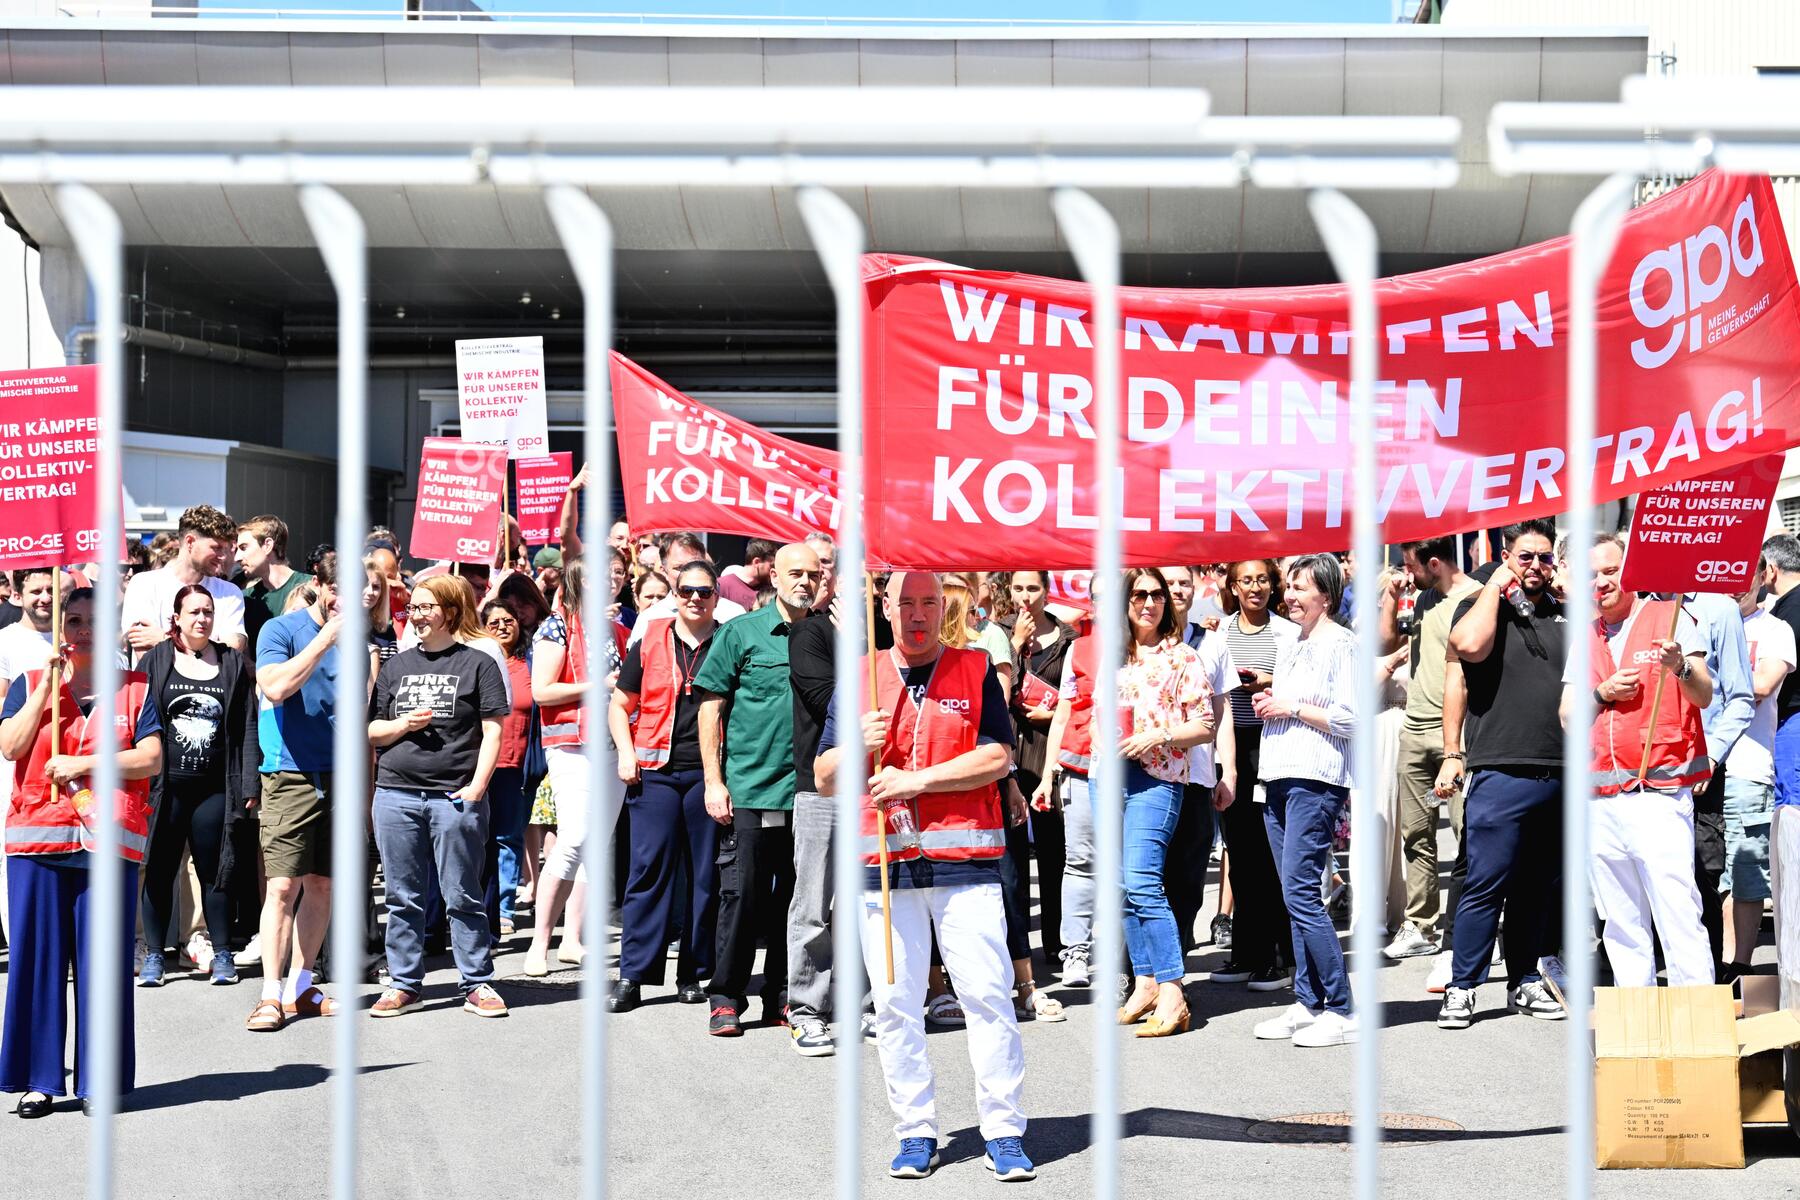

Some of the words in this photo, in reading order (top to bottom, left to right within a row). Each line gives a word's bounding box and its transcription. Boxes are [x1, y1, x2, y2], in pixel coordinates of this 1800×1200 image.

[1629, 193, 1764, 369] gpa
[939, 279, 1094, 348] WIR
[1708, 305, 1737, 330] MEINE
[1708, 293, 1770, 344] GEWERKSCHAFT
[463, 371, 484, 381] WIR
[34, 385, 79, 395] INDUSTRIE
[488, 381, 539, 393] UNSEREN
[465, 395, 528, 407] KOLLEKTIV-
[937, 354, 1097, 439] FÜR
[466, 408, 518, 420] VERTRAG!
[0, 423, 21, 438] IR
[517, 437, 543, 451] gpa
[648, 415, 738, 462] FÜR
[0, 460, 93, 480] OLLEKTIV-
[427, 459, 448, 470] WIR
[425, 471, 478, 487] KÄMPFEN
[520, 478, 534, 486] WIR
[535, 476, 570, 485] KÄMPFEN
[0, 482, 77, 501] ERTRAG!
[423, 484, 445, 497] FÜR
[447, 487, 498, 502] UNSEREN
[520, 486, 535, 495] FÜR
[421, 498, 485, 513] KOLLEKTIV-
[521, 496, 562, 505] KOLLEKTIV-
[1645, 495, 1680, 510] FÜR
[1685, 498, 1766, 511] UNSEREN
[521, 505, 557, 515] VERTRAG!
[420, 511, 472, 526] VERTRAG!
[1641, 514, 1743, 527] KOLLEKTIV-
[1639, 531, 1722, 544] VERTRAG!
[456, 537, 491, 556] gpa
[1694, 560, 1748, 582] gpa
[1633, 650, 1658, 664] gpa
[407, 675, 450, 685] PINK
[939, 698, 970, 714] gpa
